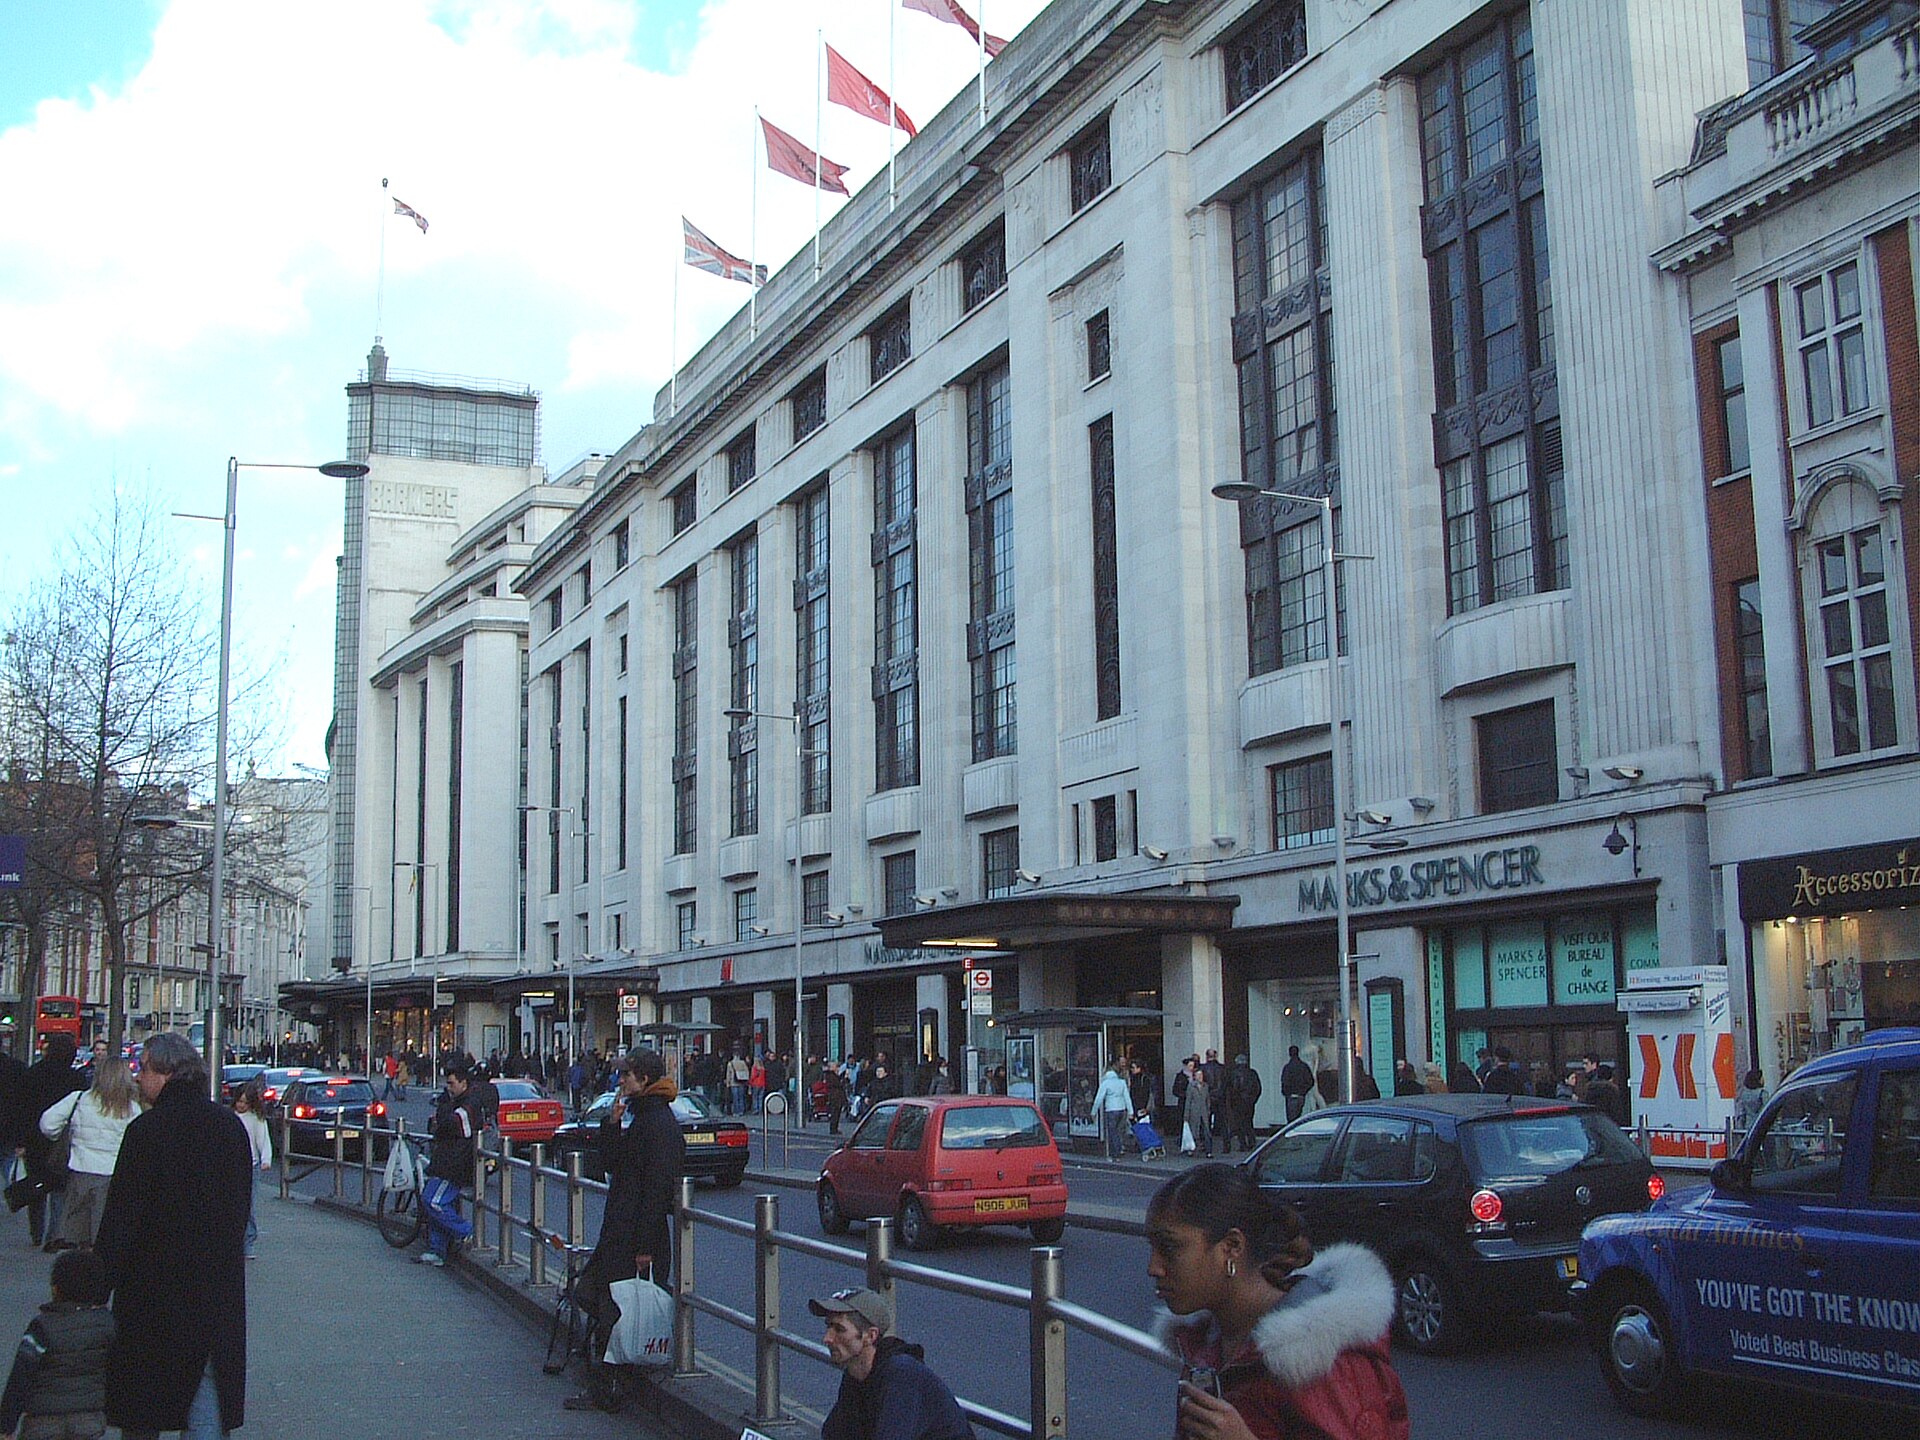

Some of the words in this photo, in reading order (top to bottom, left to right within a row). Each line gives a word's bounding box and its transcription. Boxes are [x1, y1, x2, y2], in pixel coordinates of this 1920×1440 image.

[0, 872, 21, 882] ink
[1587, 931, 1610, 945] OUR
[1497, 952, 1534, 965] MARKS
[1537, 950, 1546, 962] &
[1567, 948, 1605, 962] BUREAU
[964, 959, 972, 969] E
[1581, 964, 1593, 978] de
[1497, 965, 1546, 981] SPENCER
[1567, 980, 1609, 995] CHANGE
[1696, 1278, 1762, 1313] YOU'VE
[1766, 1286, 1805, 1318] GOT
[1810, 1291, 1853, 1325] THE
[1729, 1328, 1770, 1354] Voted
[1772, 1334, 1807, 1360] Best
[1809, 1339, 1880, 1371] Business
[1883, 1350, 1920, 1377] Clas
